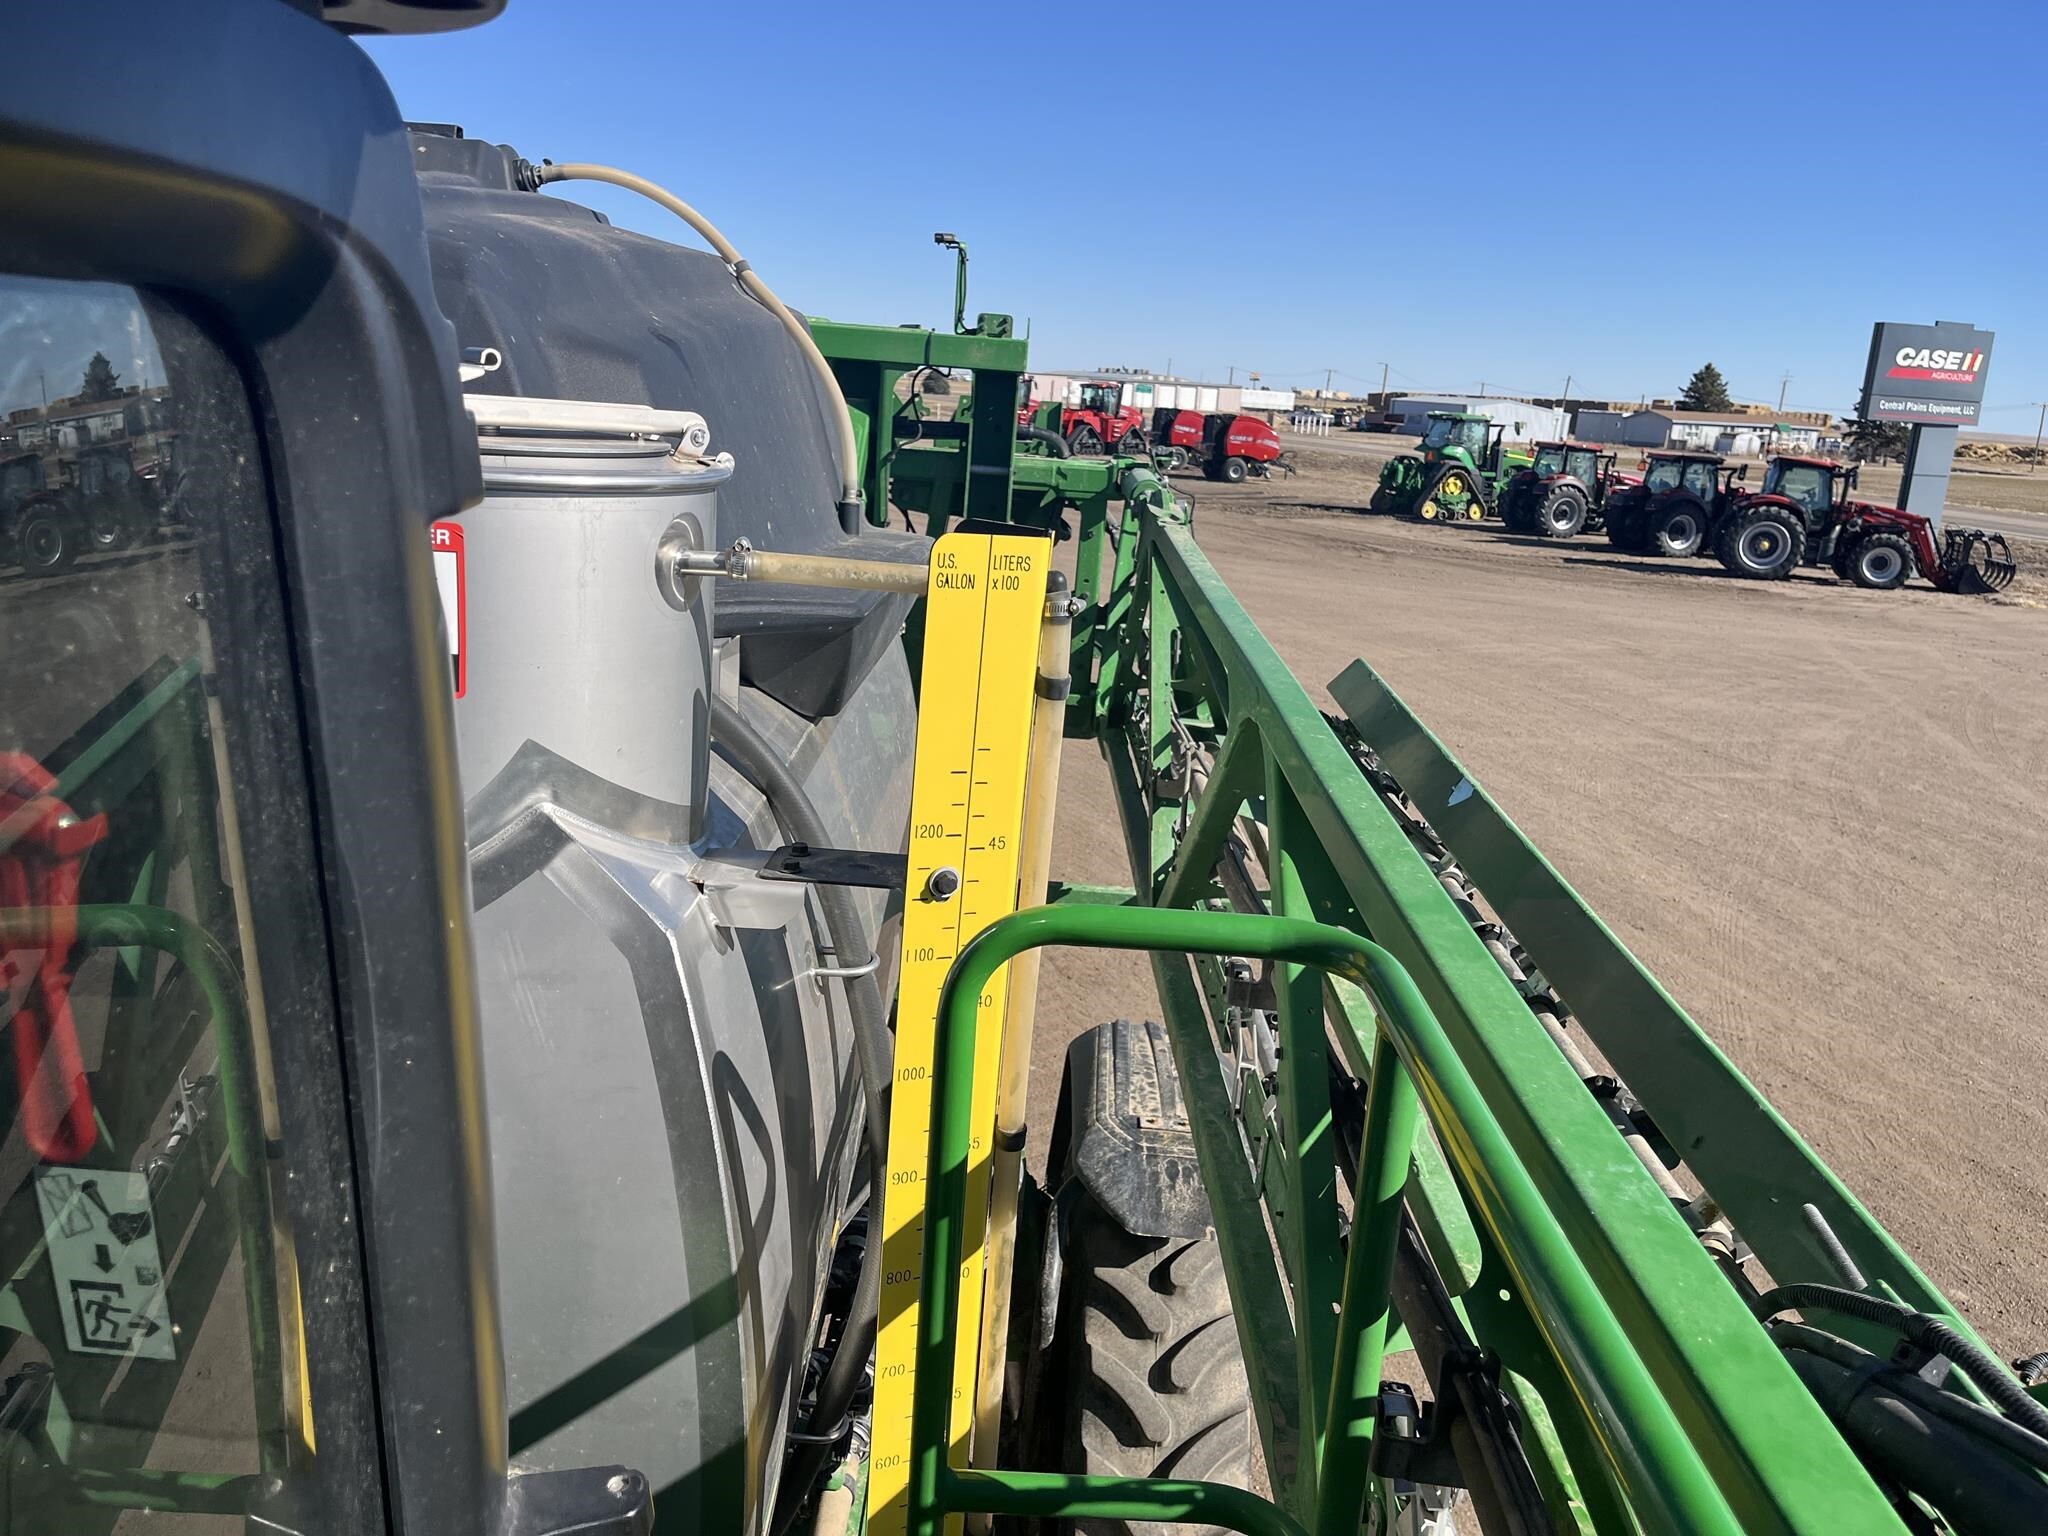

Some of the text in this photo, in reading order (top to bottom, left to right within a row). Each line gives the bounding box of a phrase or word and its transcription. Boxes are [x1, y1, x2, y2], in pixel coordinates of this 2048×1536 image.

[1895, 347, 1963, 369] CASE
[1931, 371, 1974, 382] AGRICULTURE
[1879, 400, 1906, 411] Central
[1906, 402, 1928, 412] Plains
[1964, 406, 1975, 415] LLC
[936, 552, 958, 570] U.S.
[992, 554, 1032, 573] LITERS
[935, 571, 976, 590] GALLON
[991, 575, 1020, 591] x100
[914, 823, 943, 840] 1200
[988, 835, 1006, 851] 45
[906, 947, 934, 964] 1100
[897, 1066, 926, 1083] 1000
[892, 1169, 918, 1186] 900
[886, 1269, 912, 1286] 800
[881, 1363, 905, 1379] 700
[875, 1454, 900, 1470] 600
